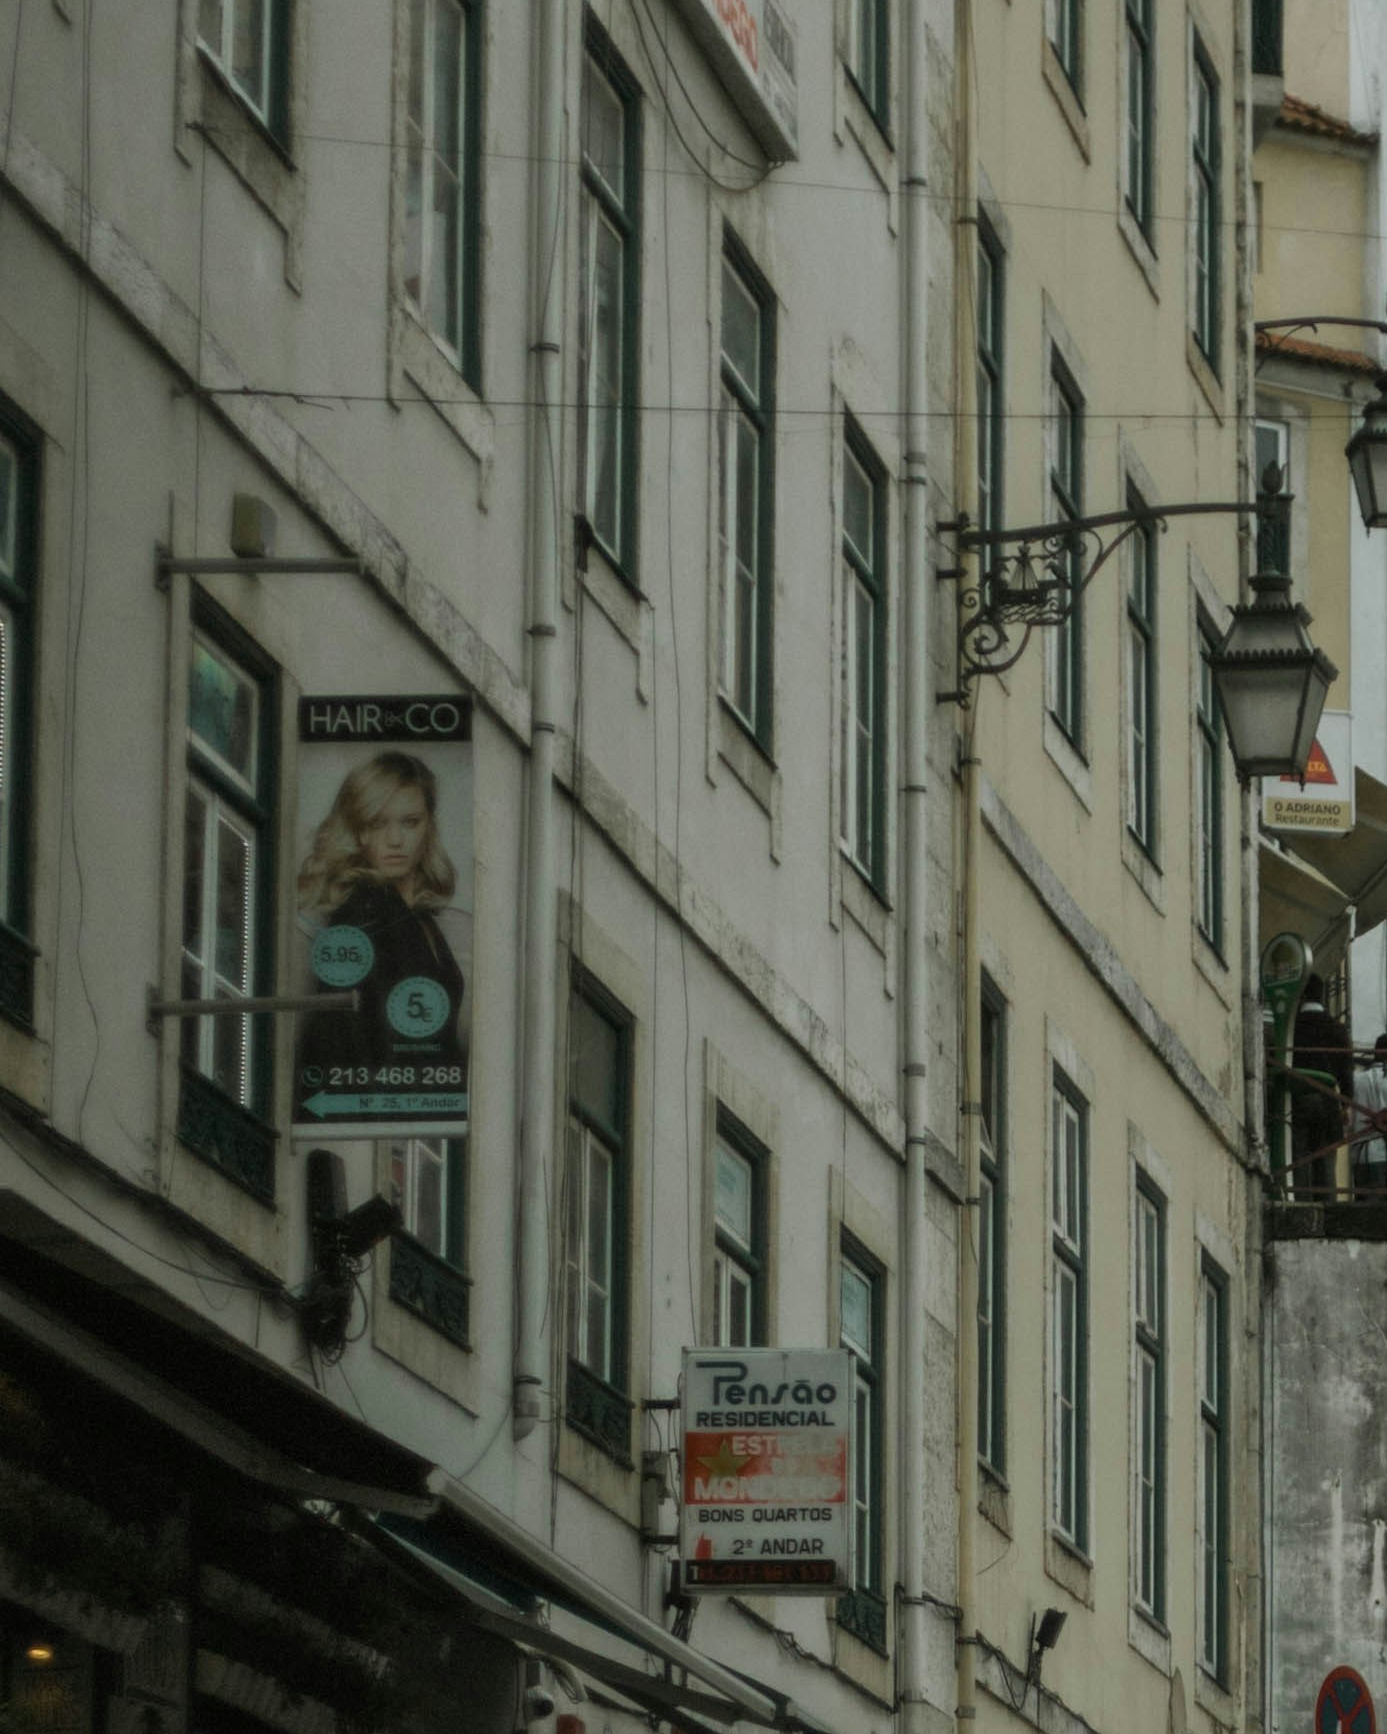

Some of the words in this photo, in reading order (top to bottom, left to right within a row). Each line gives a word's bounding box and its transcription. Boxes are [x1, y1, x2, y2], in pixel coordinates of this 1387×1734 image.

[310, 704, 383, 733] HAIR
[405, 703, 460, 733] CO
[1274, 801, 1283, 812] O
[1286, 802, 1341, 815] ADRIANO
[1275, 813, 1340, 826] Restaurante
[329, 1067, 368, 1085] 213
[375, 1067, 416, 1085] 468
[422, 1067, 462, 1085] 268
[696, 1361, 837, 1406] Pensão
[696, 1411, 835, 1427] RESIDENCIAL
[698, 1508, 745, 1523] BONS
[752, 1507, 832, 1523] QUARTOS
[760, 1538, 824, 1555] ANDAR
